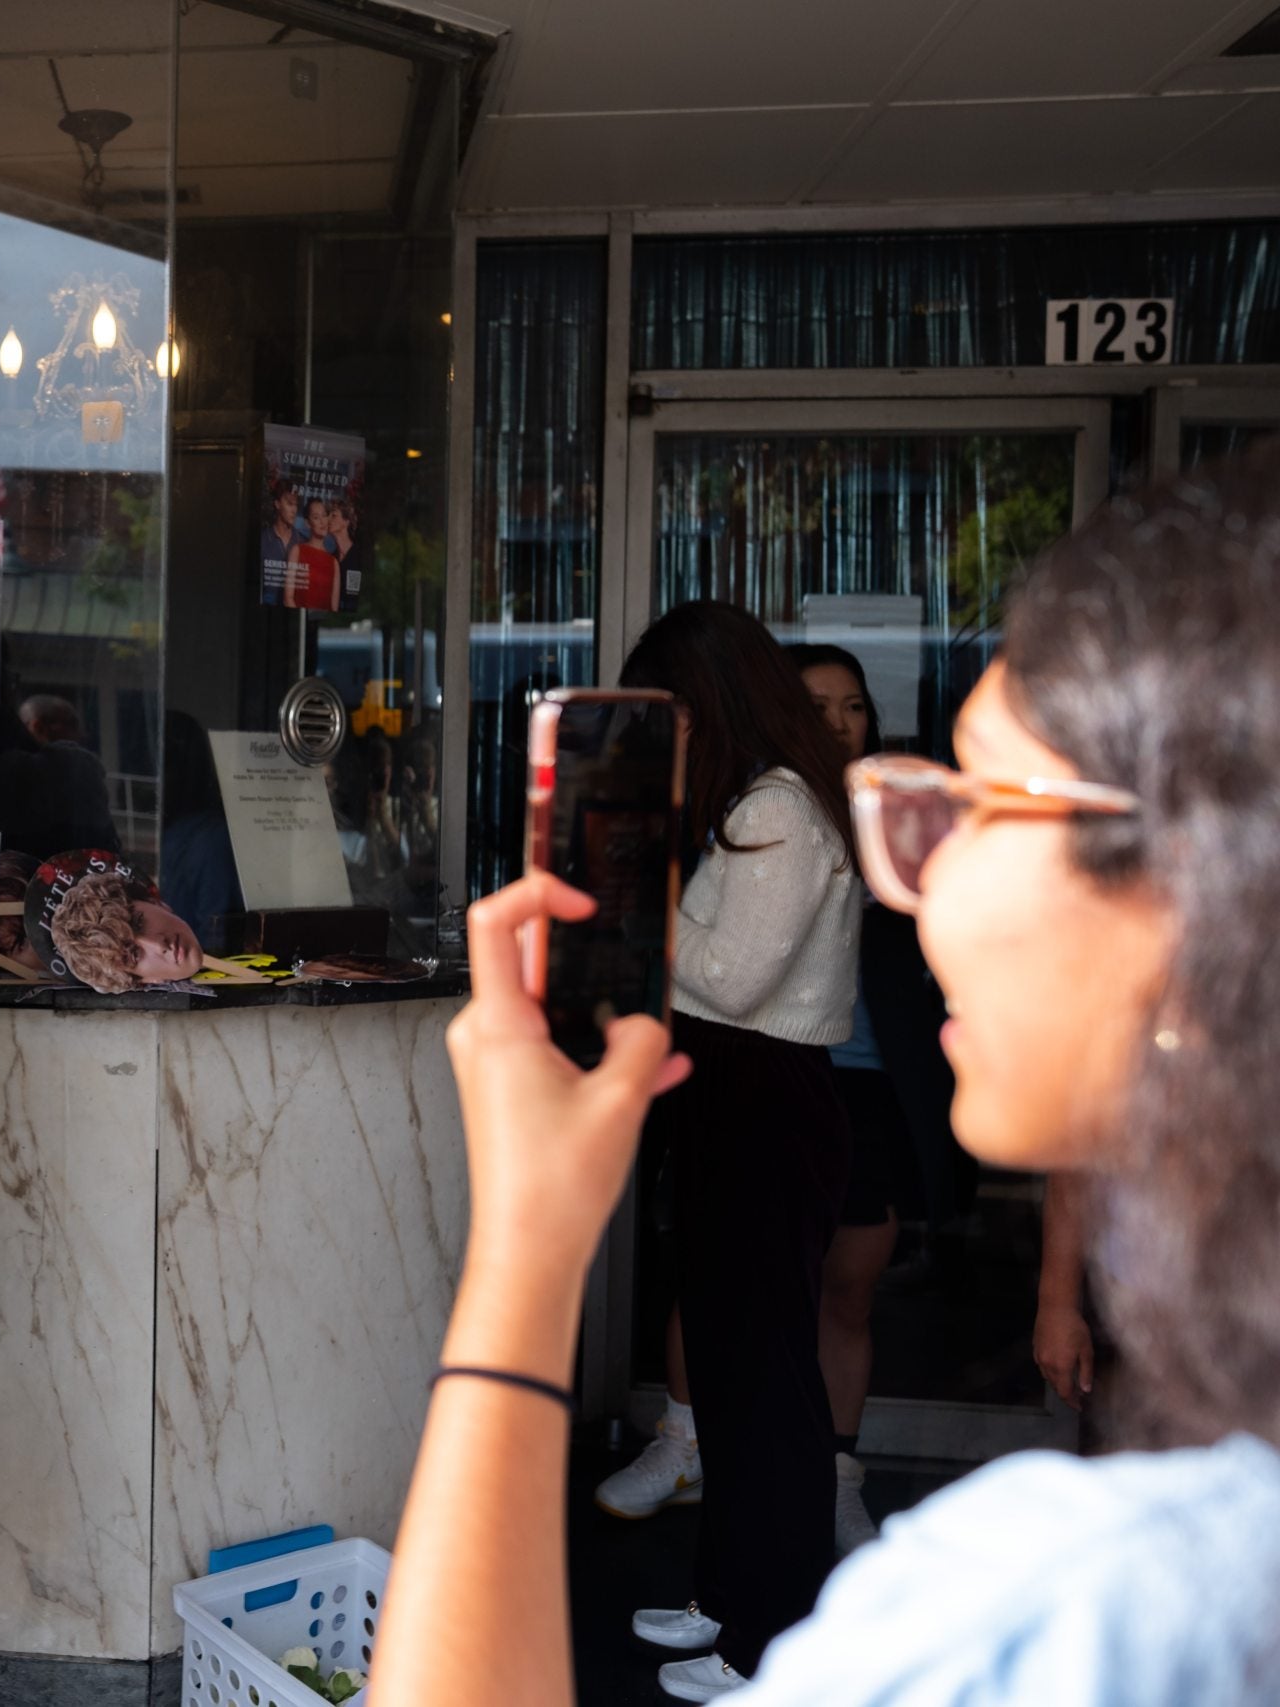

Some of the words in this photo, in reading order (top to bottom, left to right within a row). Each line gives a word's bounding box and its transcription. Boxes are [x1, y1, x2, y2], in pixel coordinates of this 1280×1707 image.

[1056, 302, 1167, 362] 123
[303, 439, 327, 453] THE
[283, 452, 329, 468] SUMMER
[305, 470, 348, 487] TURNED
[291, 484, 335, 500] PRETTY
